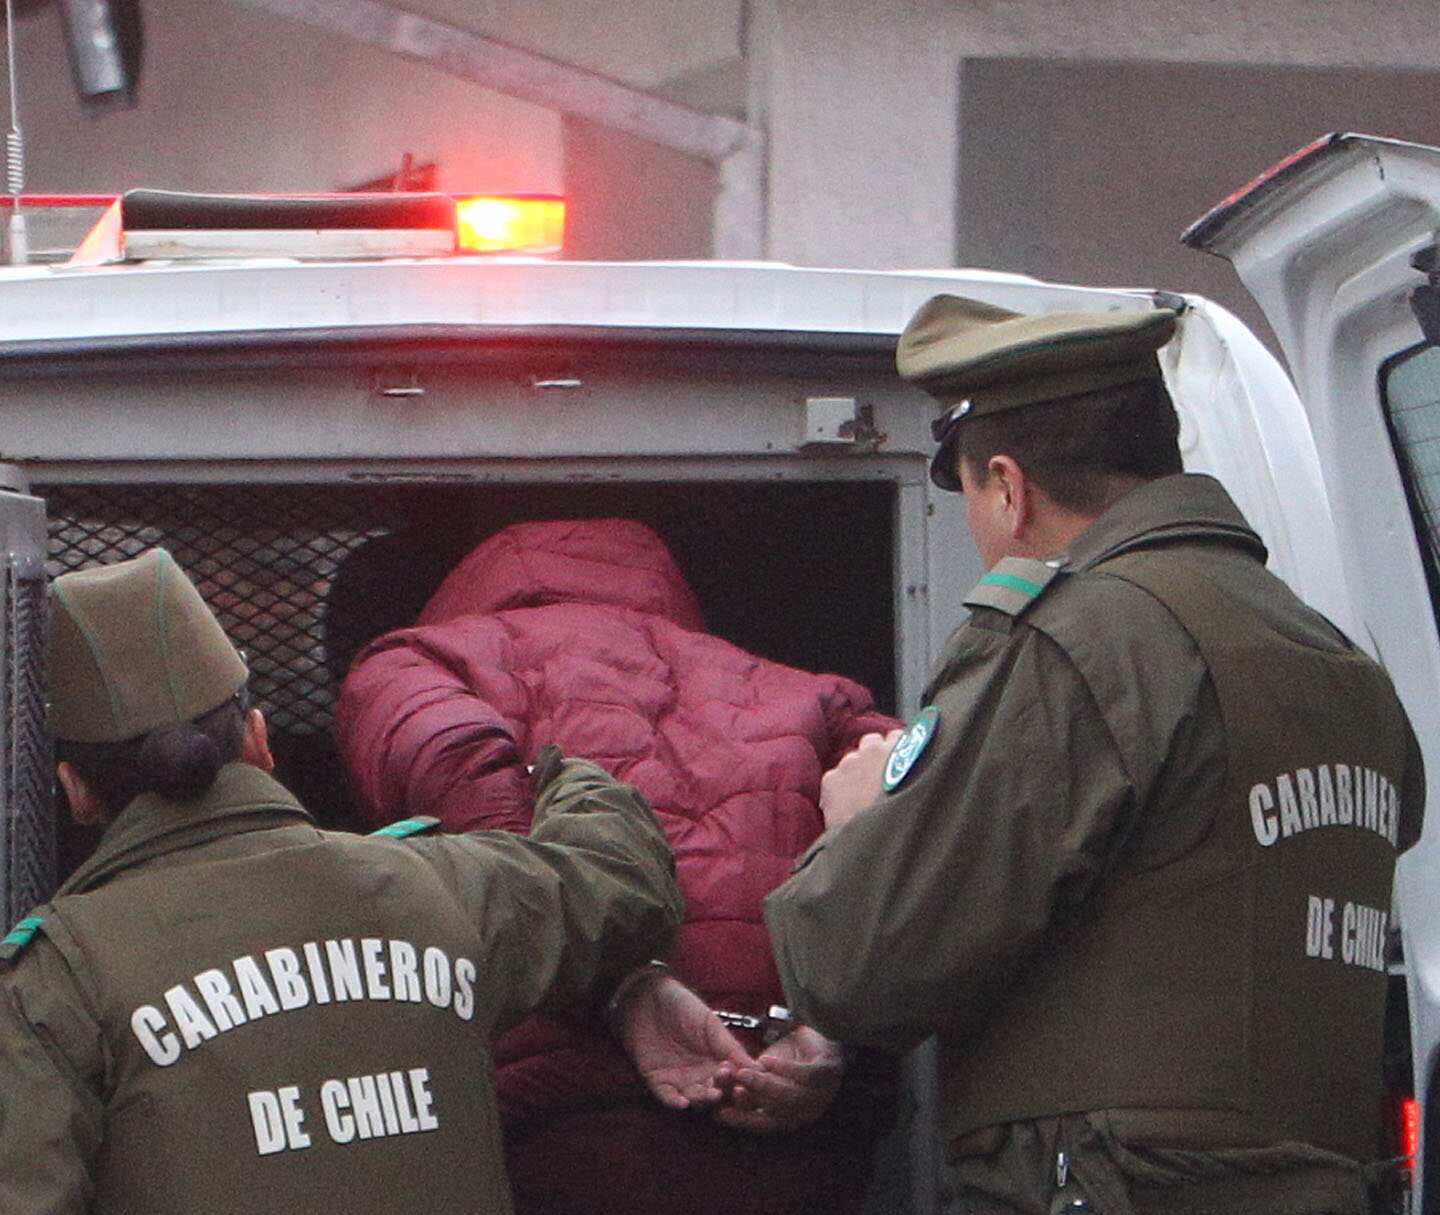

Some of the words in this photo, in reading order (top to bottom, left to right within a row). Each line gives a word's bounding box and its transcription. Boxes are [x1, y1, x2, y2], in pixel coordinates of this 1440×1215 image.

[1248, 763, 1400, 848] CARABINER
[1306, 895, 1334, 959] DE
[1342, 901, 1387, 972] CHILE
[131, 938, 477, 1066] CARABINEROS
[248, 1086, 311, 1155] DE
[321, 1067, 439, 1144] CHILE
